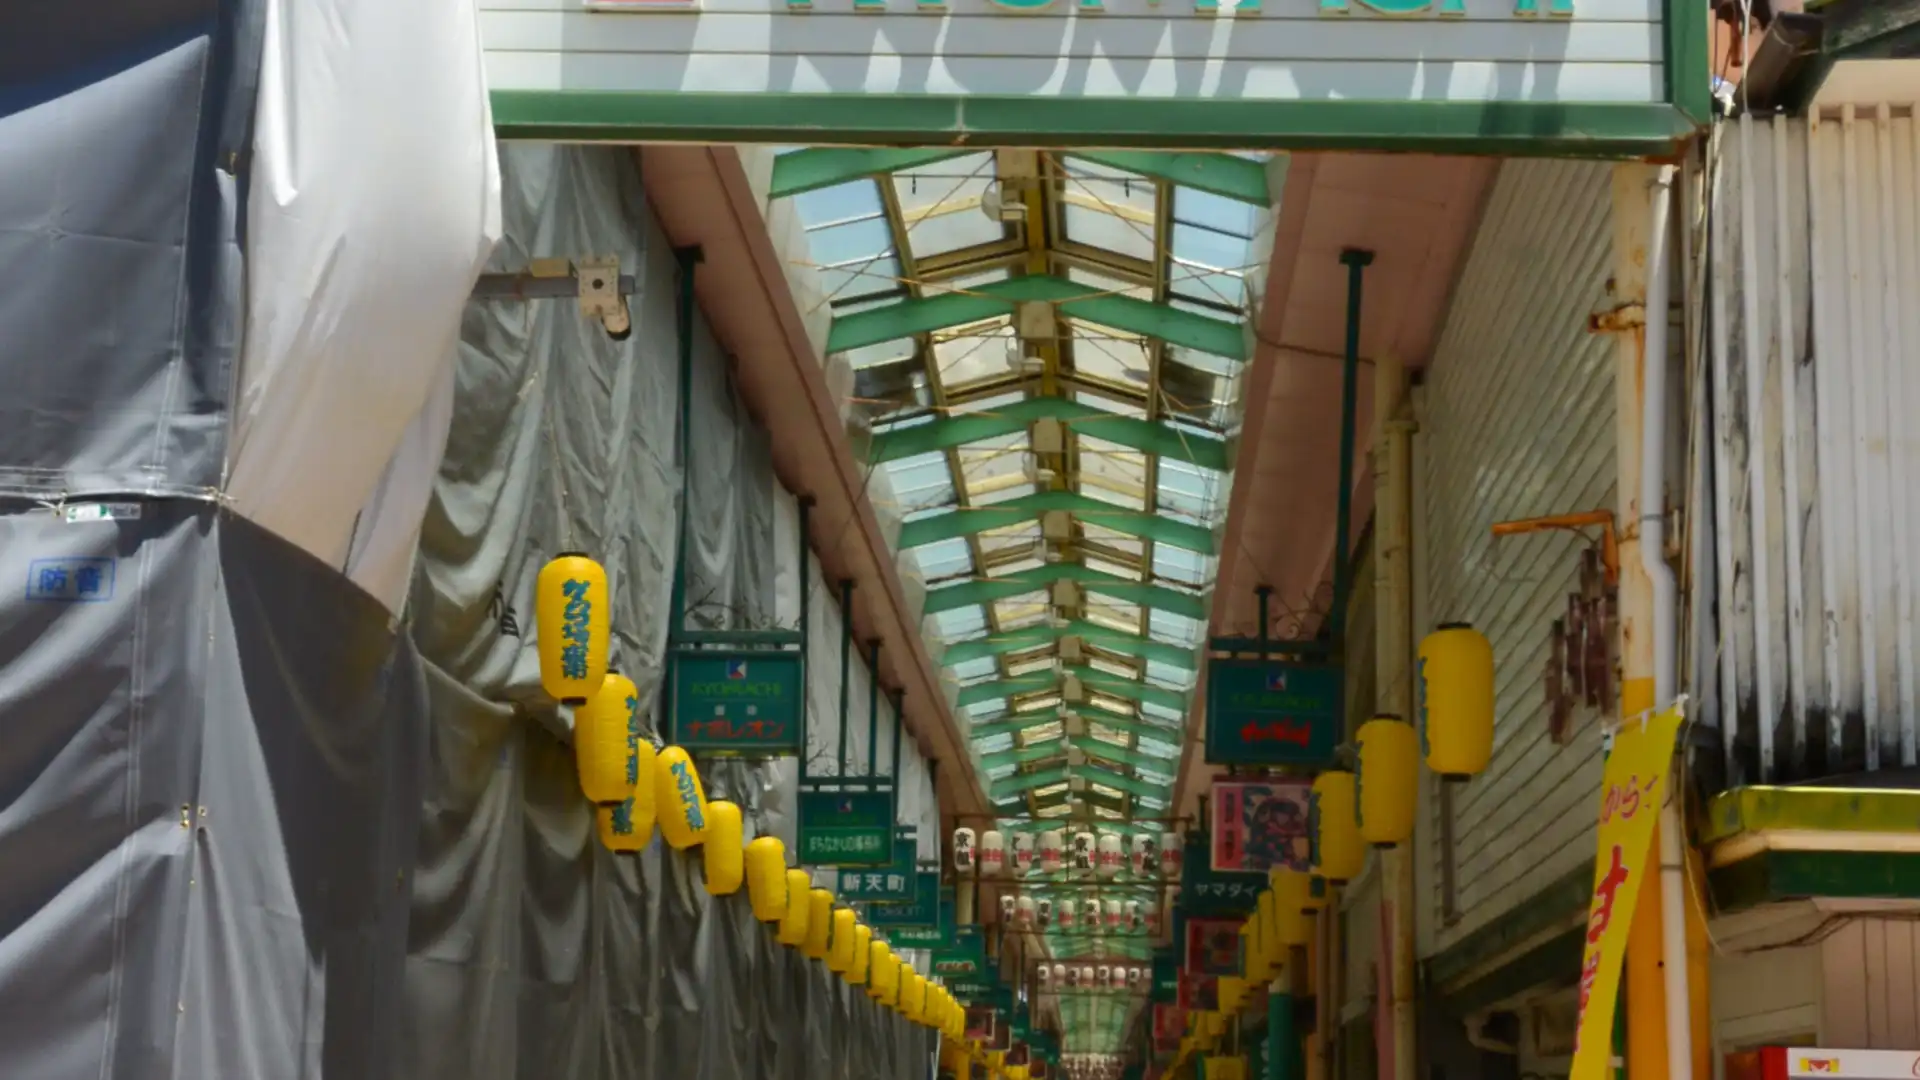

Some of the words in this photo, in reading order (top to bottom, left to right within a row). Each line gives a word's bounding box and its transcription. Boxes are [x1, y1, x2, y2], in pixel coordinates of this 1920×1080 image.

[685, 718, 786, 740] ナポレオン
[843, 872, 906, 893] 新天町
